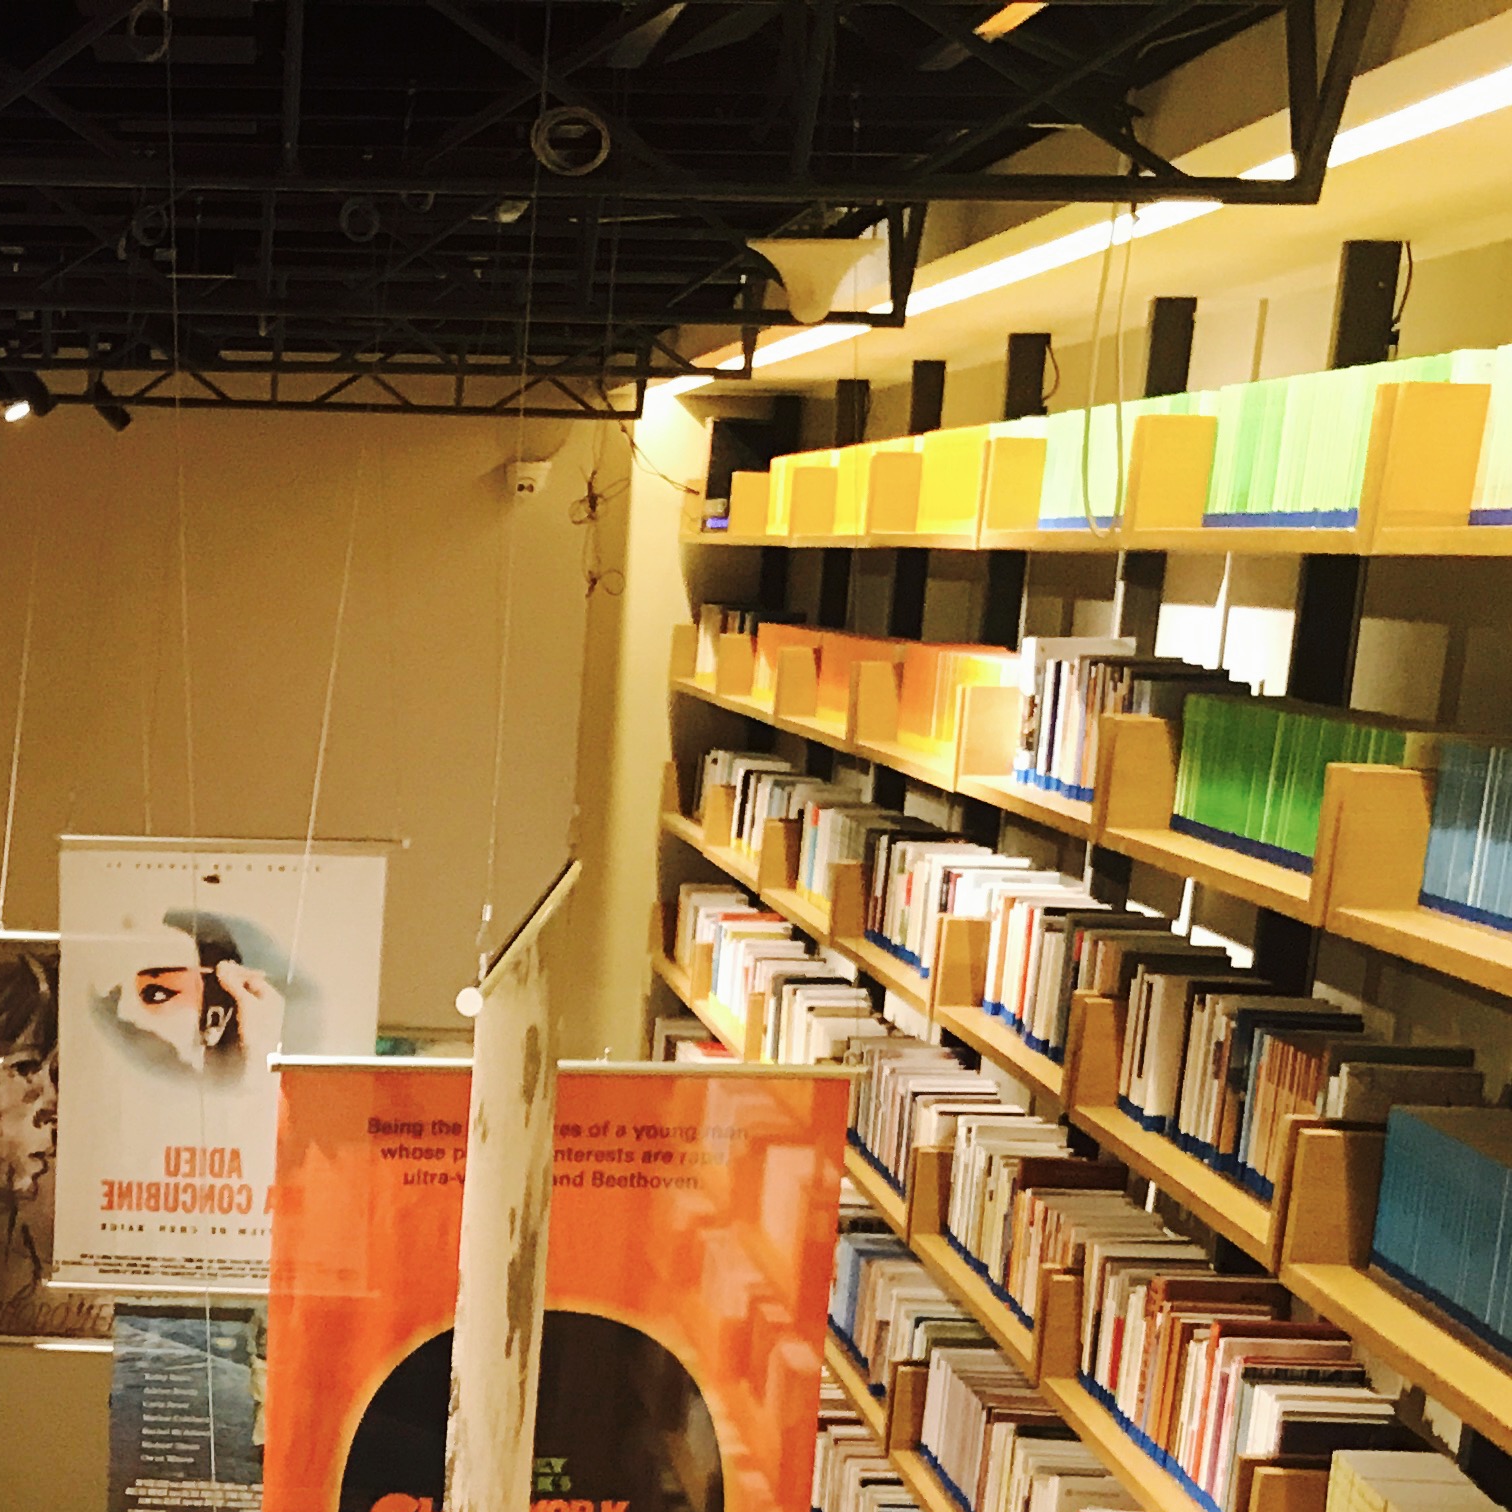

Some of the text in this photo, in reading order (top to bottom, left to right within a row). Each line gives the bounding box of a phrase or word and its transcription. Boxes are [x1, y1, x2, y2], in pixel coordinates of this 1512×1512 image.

[368, 1116, 424, 1138] Being
[431, 1119, 462, 1136] the
[588, 1120, 610, 1138] of
[614, 1124, 627, 1139] a
[632, 1123, 698, 1143] young
[381, 1144, 446, 1161] whose
[553, 1147, 635, 1164] nterests
[641, 1149, 674, 1165] are
